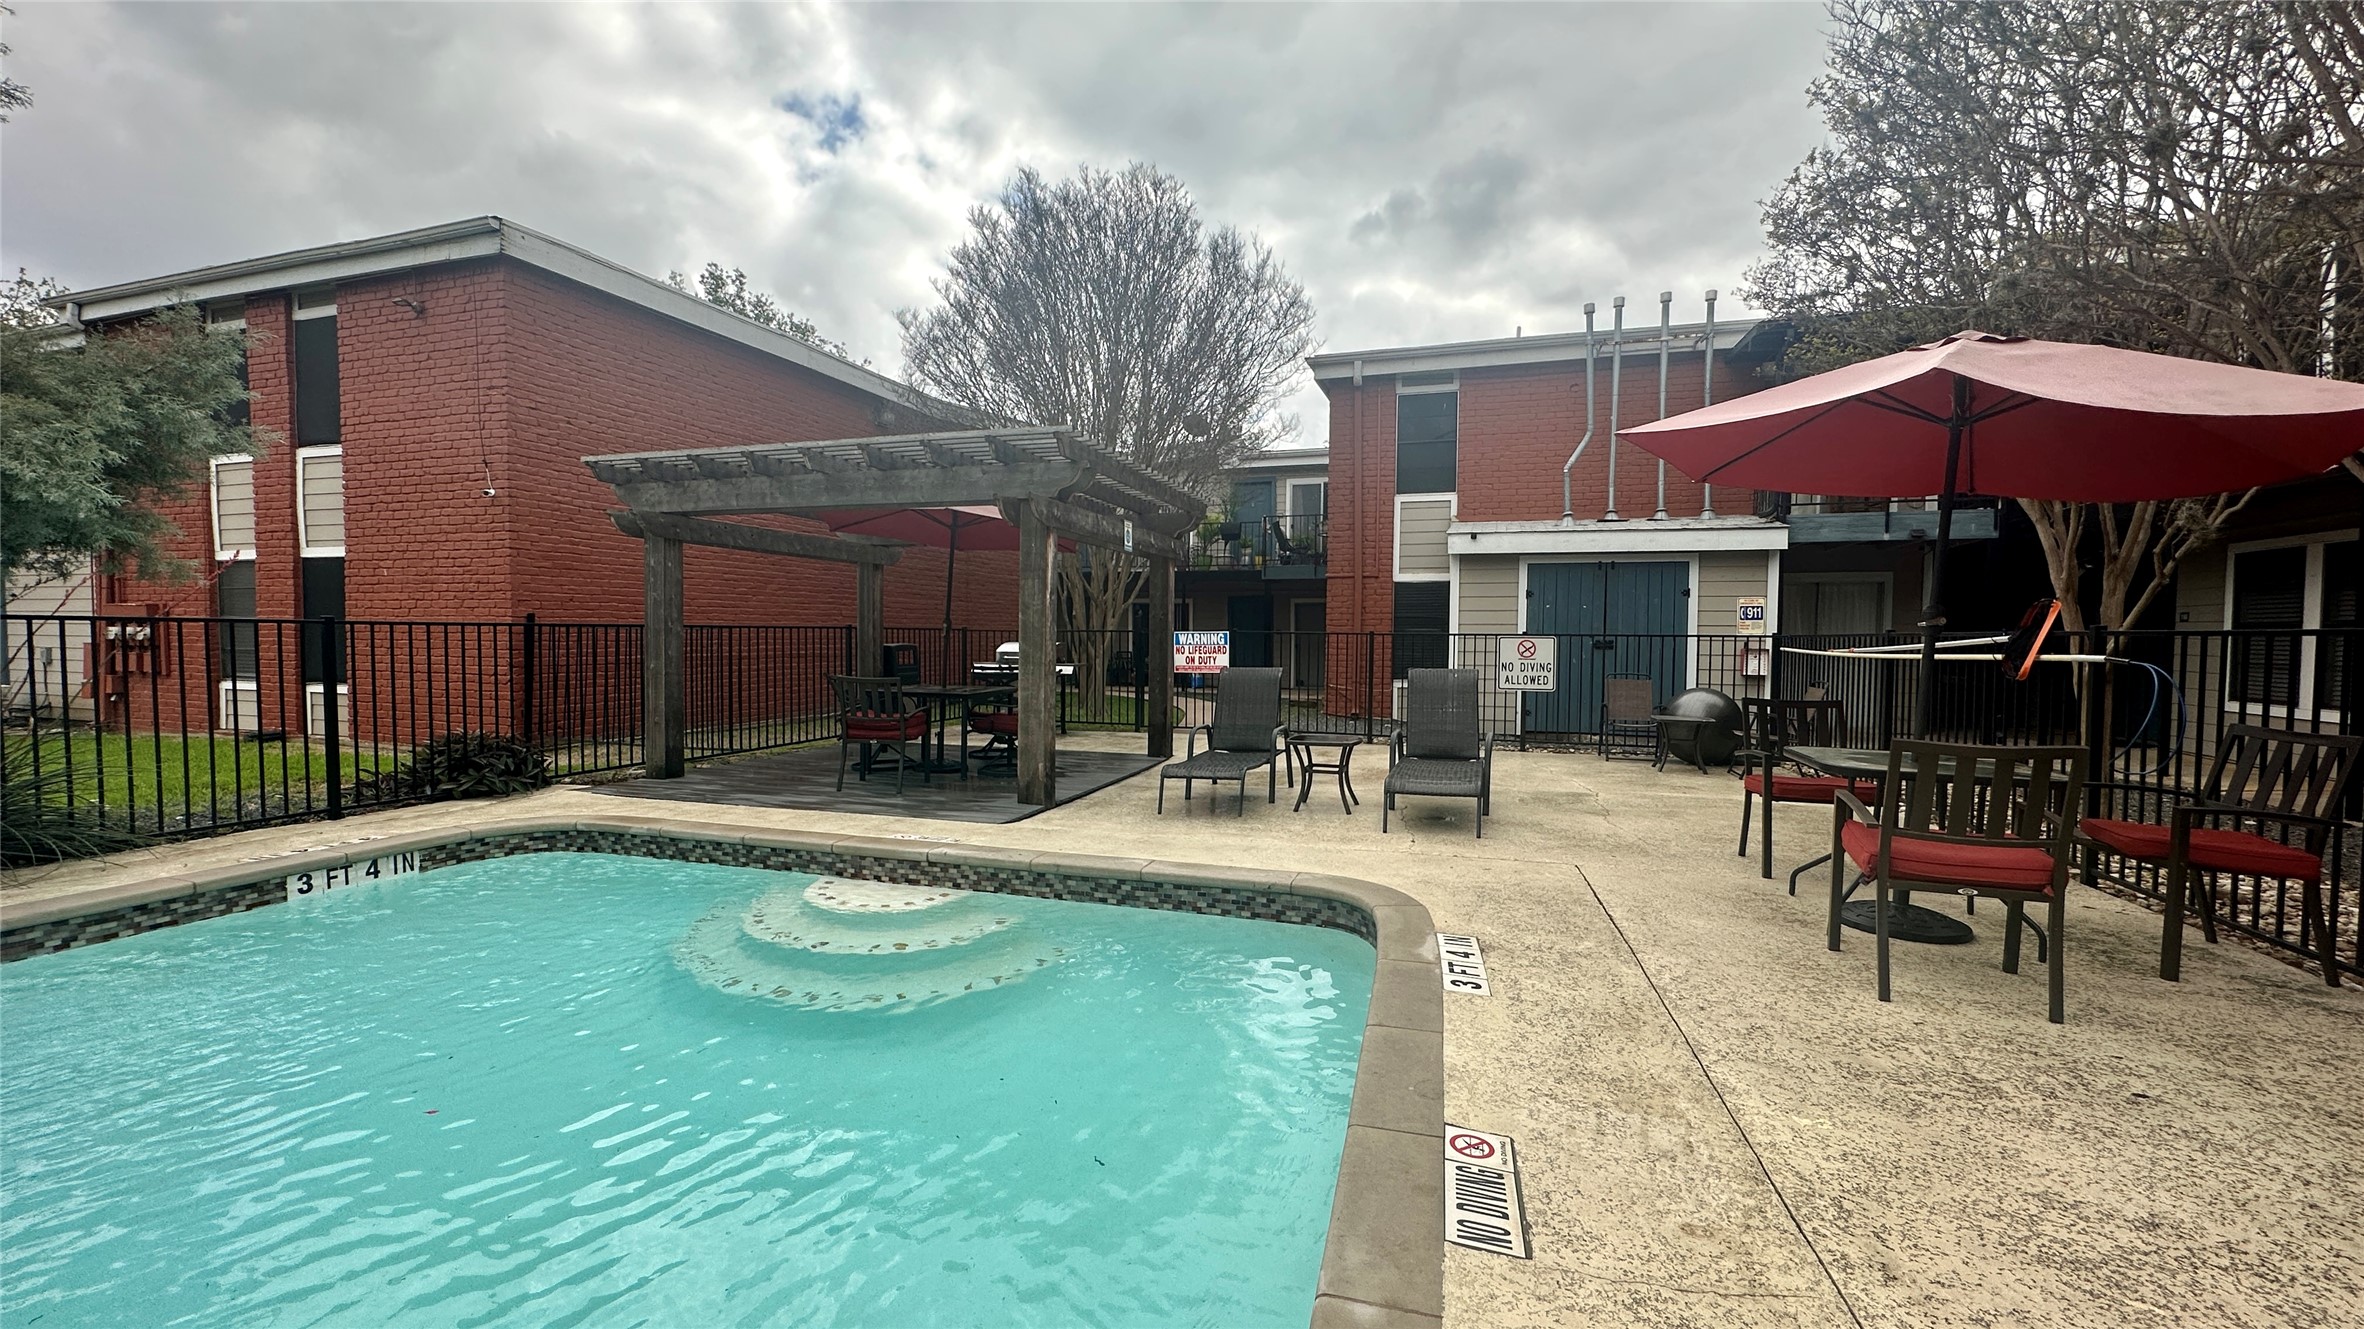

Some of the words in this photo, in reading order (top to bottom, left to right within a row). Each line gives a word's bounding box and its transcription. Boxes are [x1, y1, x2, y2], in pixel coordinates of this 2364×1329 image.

[1747, 606, 1762, 619] 911
[1178, 633, 1225, 645] WARNING
[1175, 645, 1186, 655] NO
[1188, 645, 1227, 655] LIFEGUARD
[1185, 655, 1195, 665] ON
[1198, 655, 1217, 665] DUTY
[1501, 661, 1514, 672] NO
[1520, 662, 1552, 673] DIVING
[1504, 674, 1549, 685] ALLOWED
[297, 873, 314, 895] 3
[326, 864, 353, 889] FT
[365, 858, 381, 879] 4
[393, 851, 415, 875] IN
[1442, 934, 1473, 948] IN
[1445, 949, 1475, 959] 4
[1447, 961, 1480, 977] FT
[1449, 979, 1482, 990] 3
[1455, 1165, 1510, 1220] DIVING
[1456, 1219, 1513, 1251] NO
